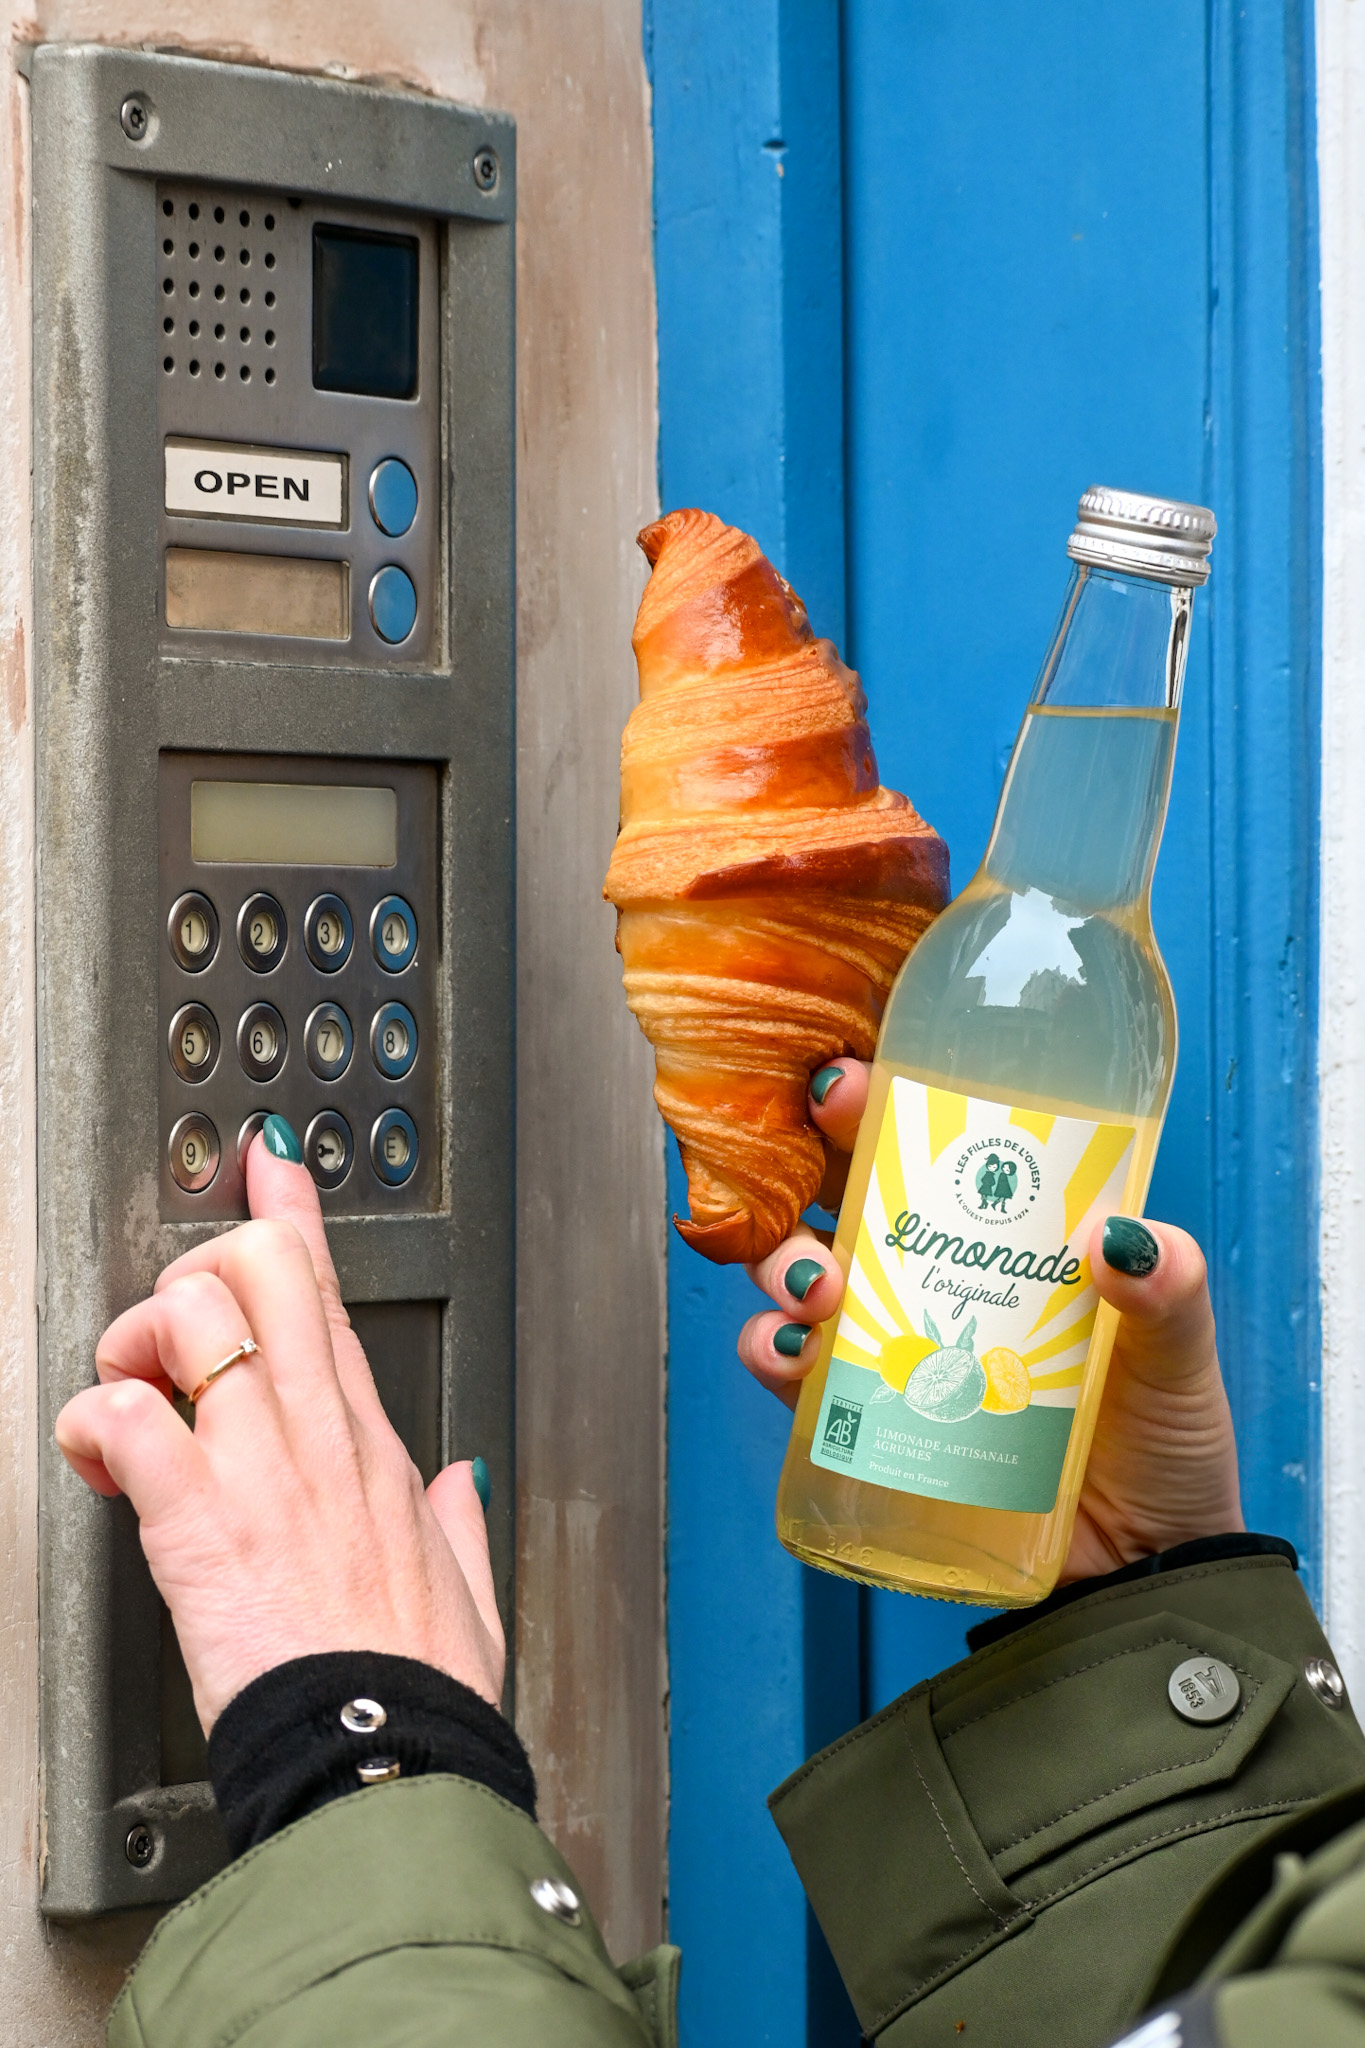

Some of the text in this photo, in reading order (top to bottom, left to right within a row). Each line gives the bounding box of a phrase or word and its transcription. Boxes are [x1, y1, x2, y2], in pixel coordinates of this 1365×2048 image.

[194, 470, 309, 501] OPEN
[185, 920, 394, 946] 1 2 3 4
[184, 1031, 395, 1055] 5 6 7 8
[186, 1137, 396, 1165] 9 E
[955, 1138, 1040, 1190] LES FILLES DE L'OUEST
[985, 1217, 1012, 1226] DEPUIS
[885, 1210, 1081, 1285] Limonade
[921, 1265, 1020, 1320] l'originale
[826, 1418, 852, 1446] AB
[876, 1426, 1019, 1465] LIMONADE ARTISANALE
[873, 1439, 932, 1462] AGRUMES
[869, 1461, 950, 1487] Produit en France
[1178, 1677, 1206, 1710] 1853
